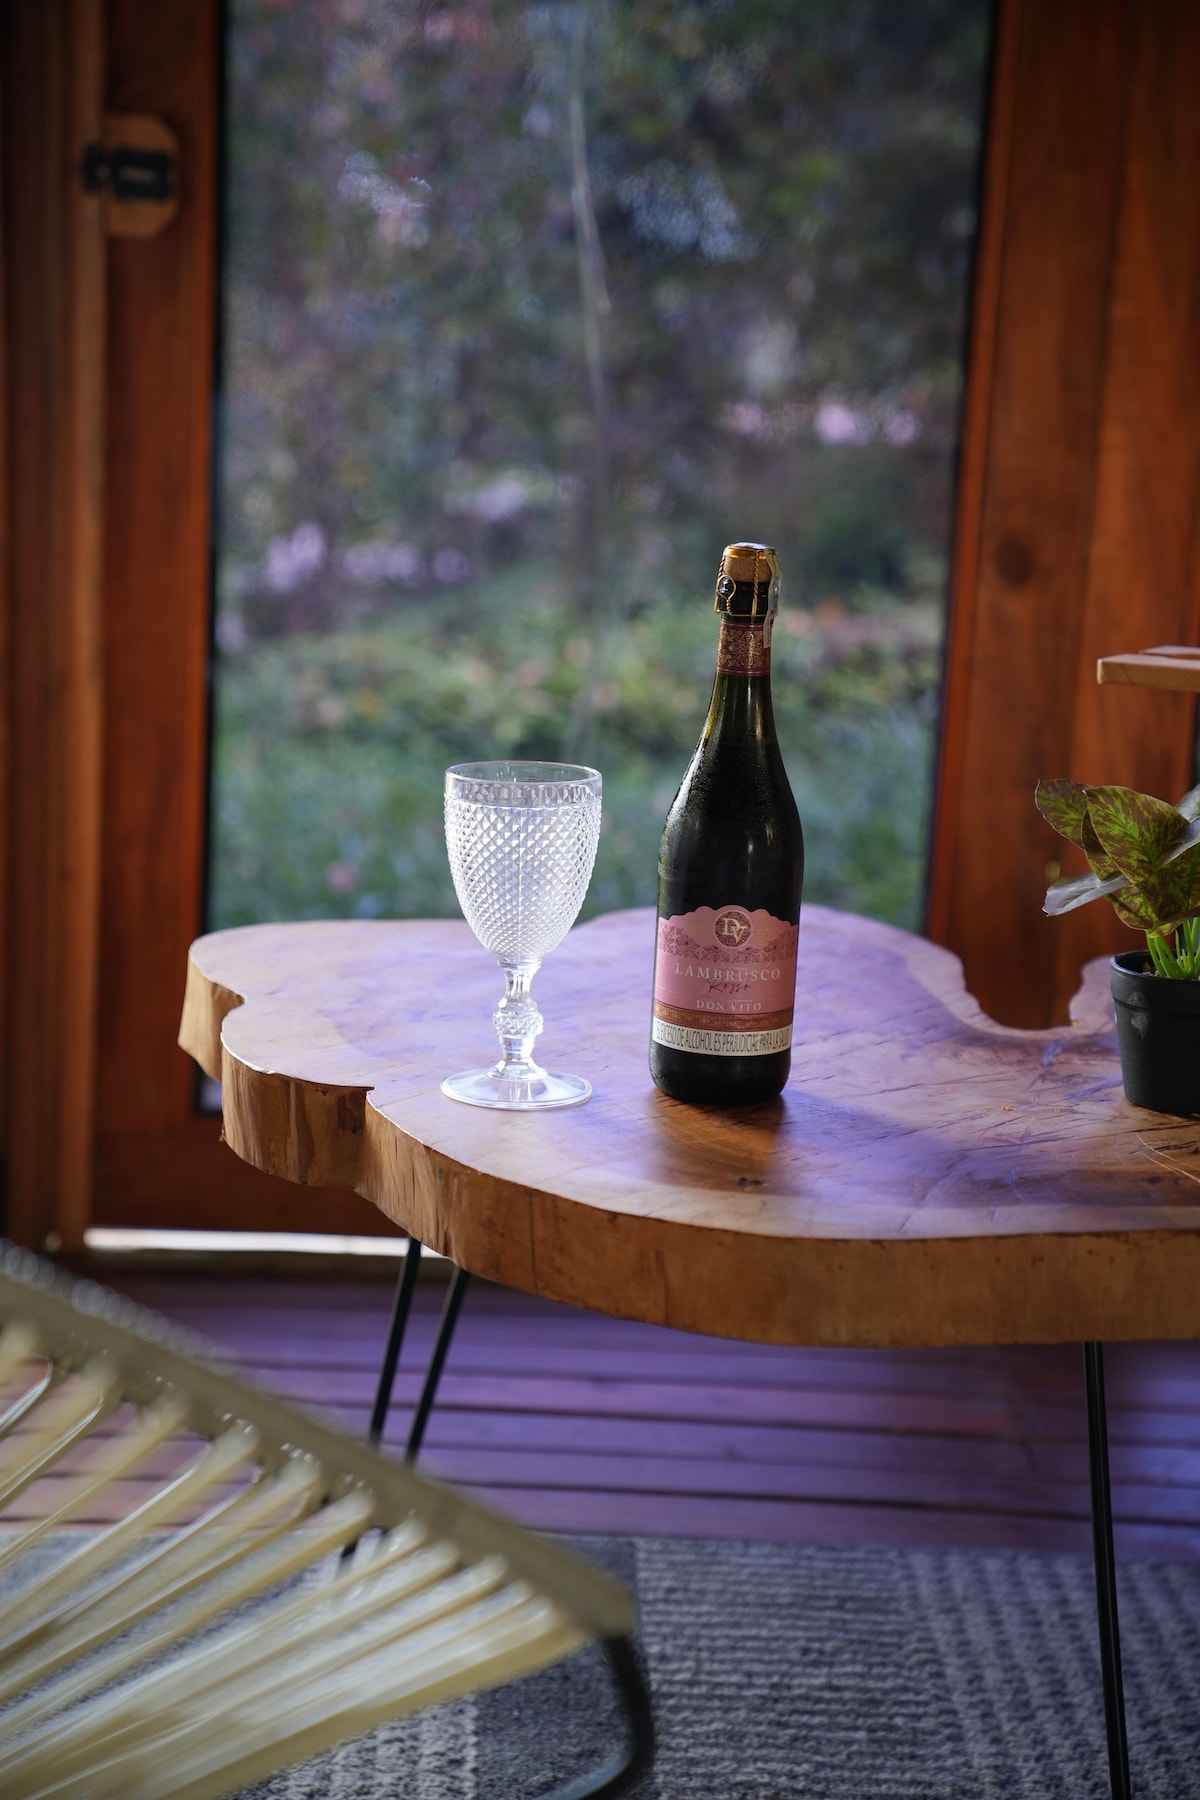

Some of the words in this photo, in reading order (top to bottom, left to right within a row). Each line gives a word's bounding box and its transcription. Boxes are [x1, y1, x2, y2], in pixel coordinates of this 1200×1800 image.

[675, 963, 780, 982] LAMBRUSCO
[696, 1000, 725, 1011] DON
[731, 1002, 762, 1012] VITO
[677, 1028, 685, 1047] DE
[685, 1029, 713, 1051] ALCOHOL
[714, 1032, 721, 1052] ES
